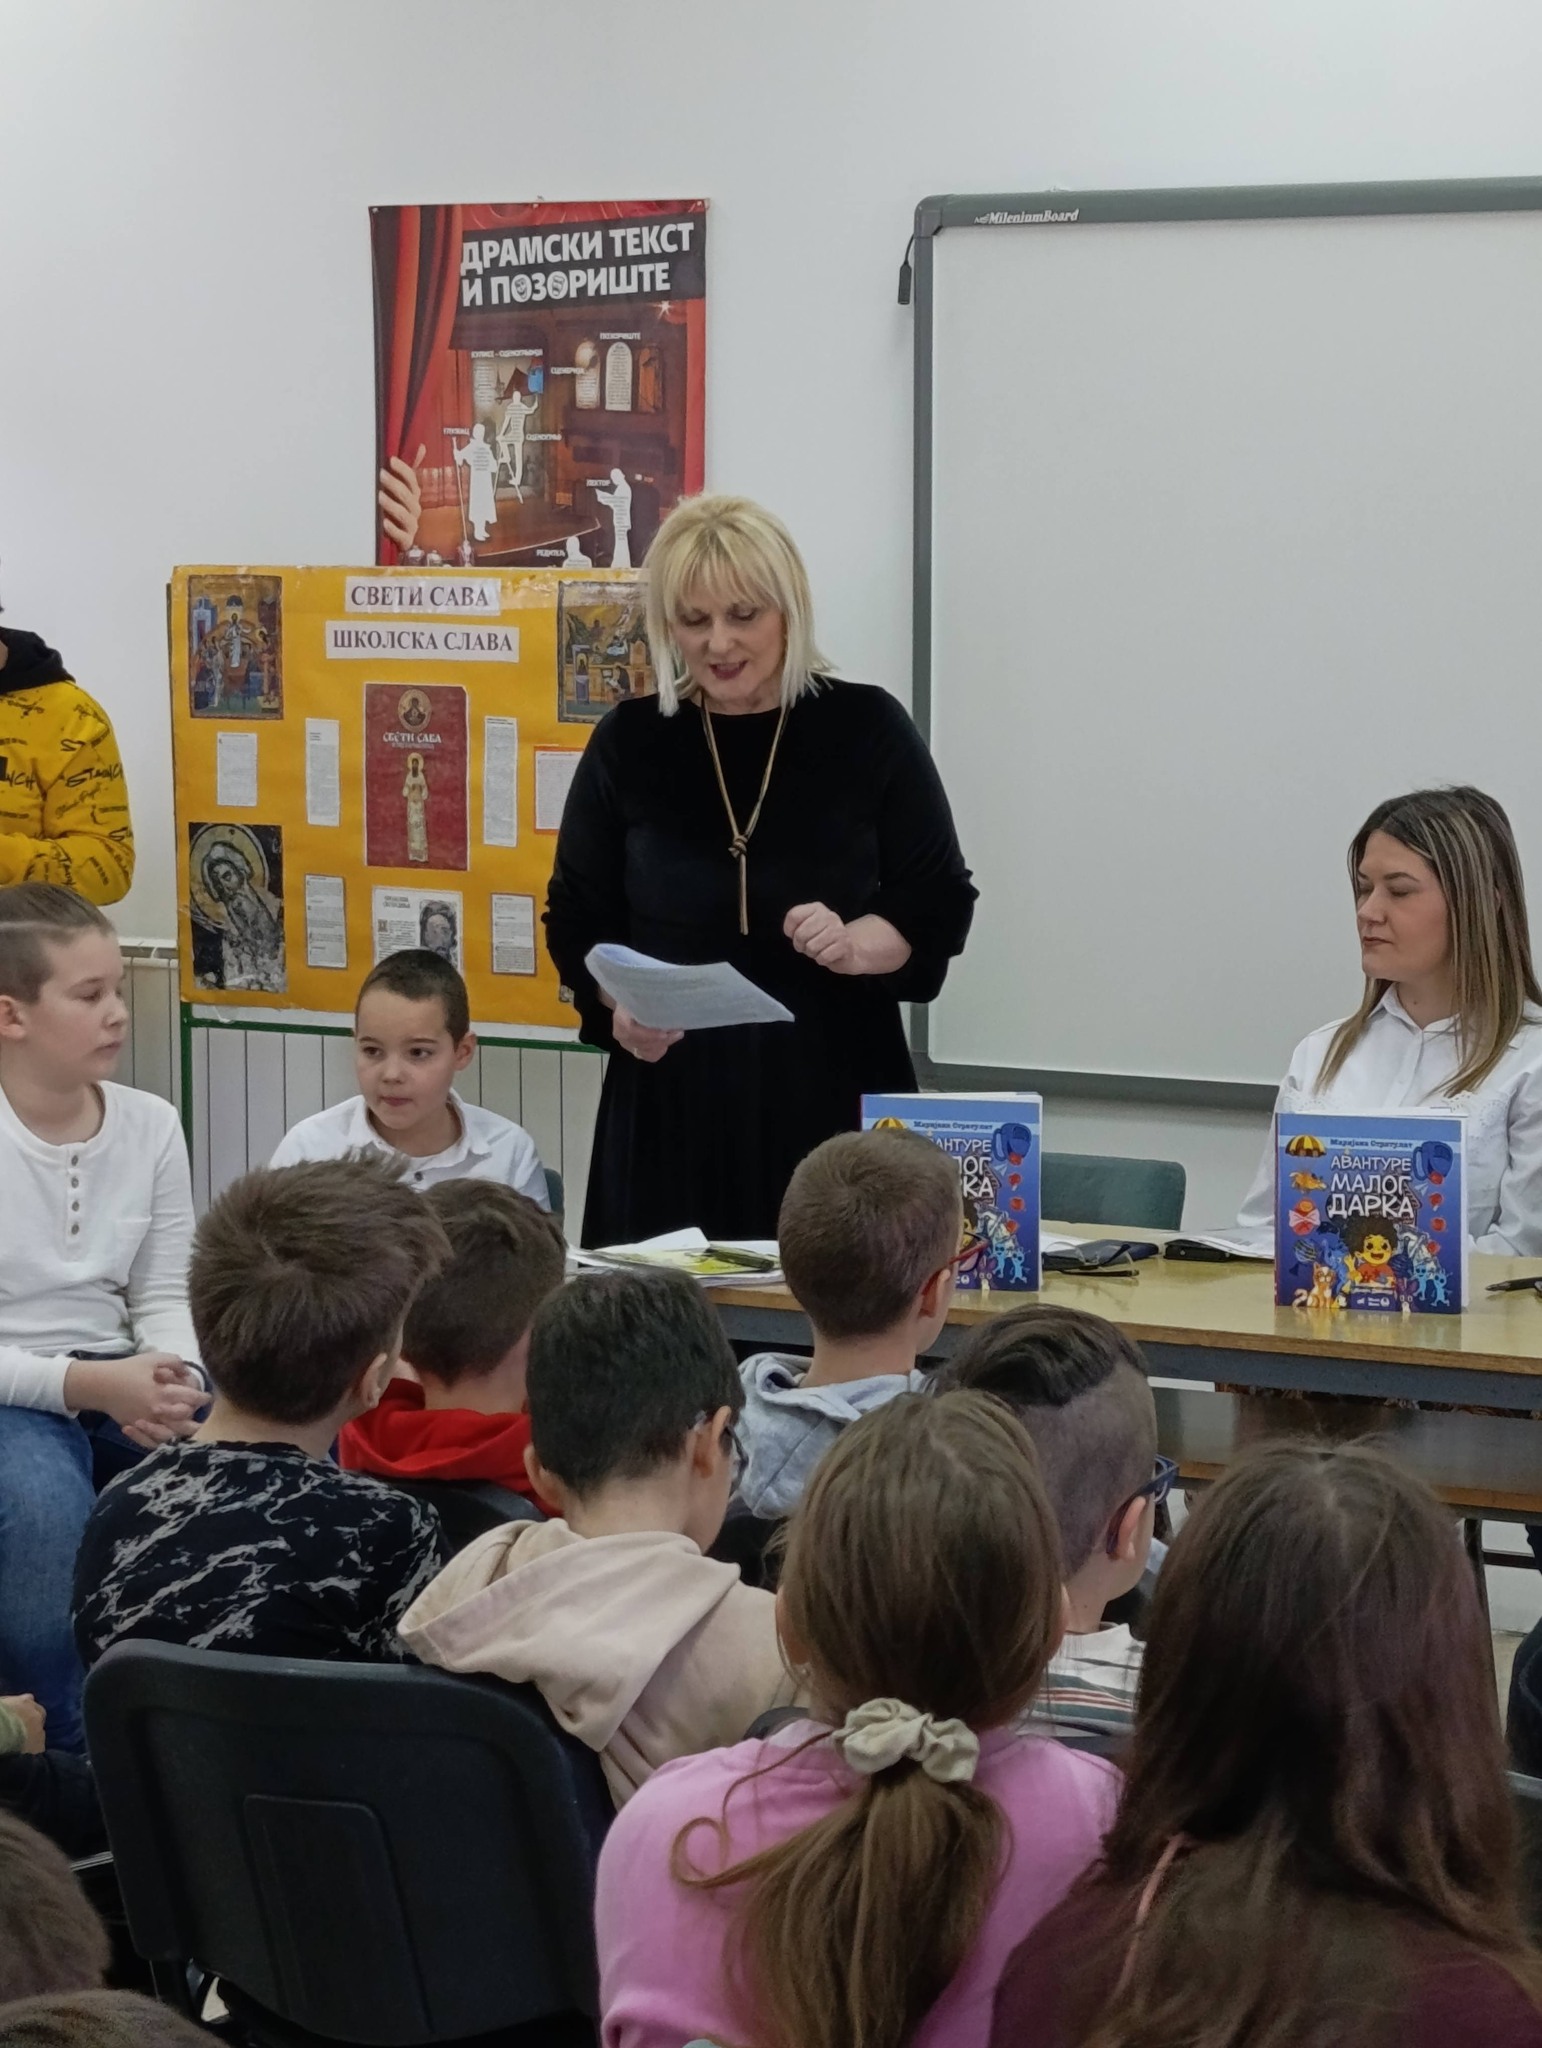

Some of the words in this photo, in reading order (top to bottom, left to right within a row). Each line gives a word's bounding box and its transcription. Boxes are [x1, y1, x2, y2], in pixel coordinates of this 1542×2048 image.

[460, 229, 604, 277] ДРАМСКИ
[609, 221, 695, 258] ТЕКСТ
[462, 277, 484, 308] И
[490, 261, 672, 304] ПОЗОРИШТЕ
[350, 584, 423, 608] СВЕТИ
[429, 586, 490, 609] САВА
[332, 629, 439, 652] ШКОЛСКА
[443, 631, 514, 653] СЛАВА
[929, 1137, 993, 1153] АНТУРЕ
[1331, 1155, 1412, 1171] АВАНТУРЕ
[1331, 1173, 1413, 1194] МАЛОГ
[1328, 1194, 1415, 1218] ДАРКА
